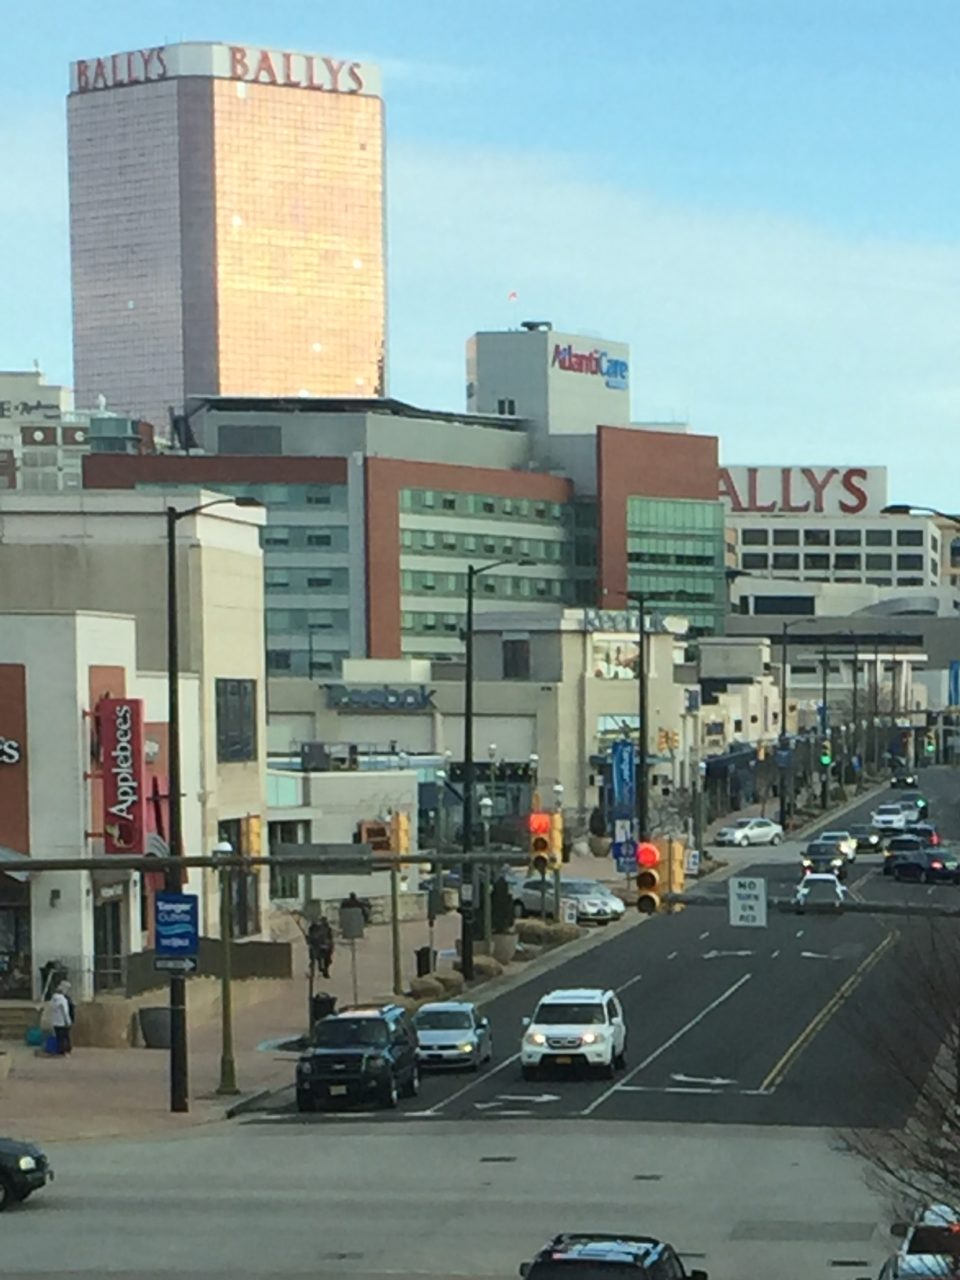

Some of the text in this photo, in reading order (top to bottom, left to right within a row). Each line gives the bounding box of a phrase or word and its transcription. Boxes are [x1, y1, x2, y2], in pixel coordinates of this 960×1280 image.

[76, 46, 167, 93] BALLYS
[229, 46, 364, 94] BALLYS
[737, 881, 757, 890] NO
